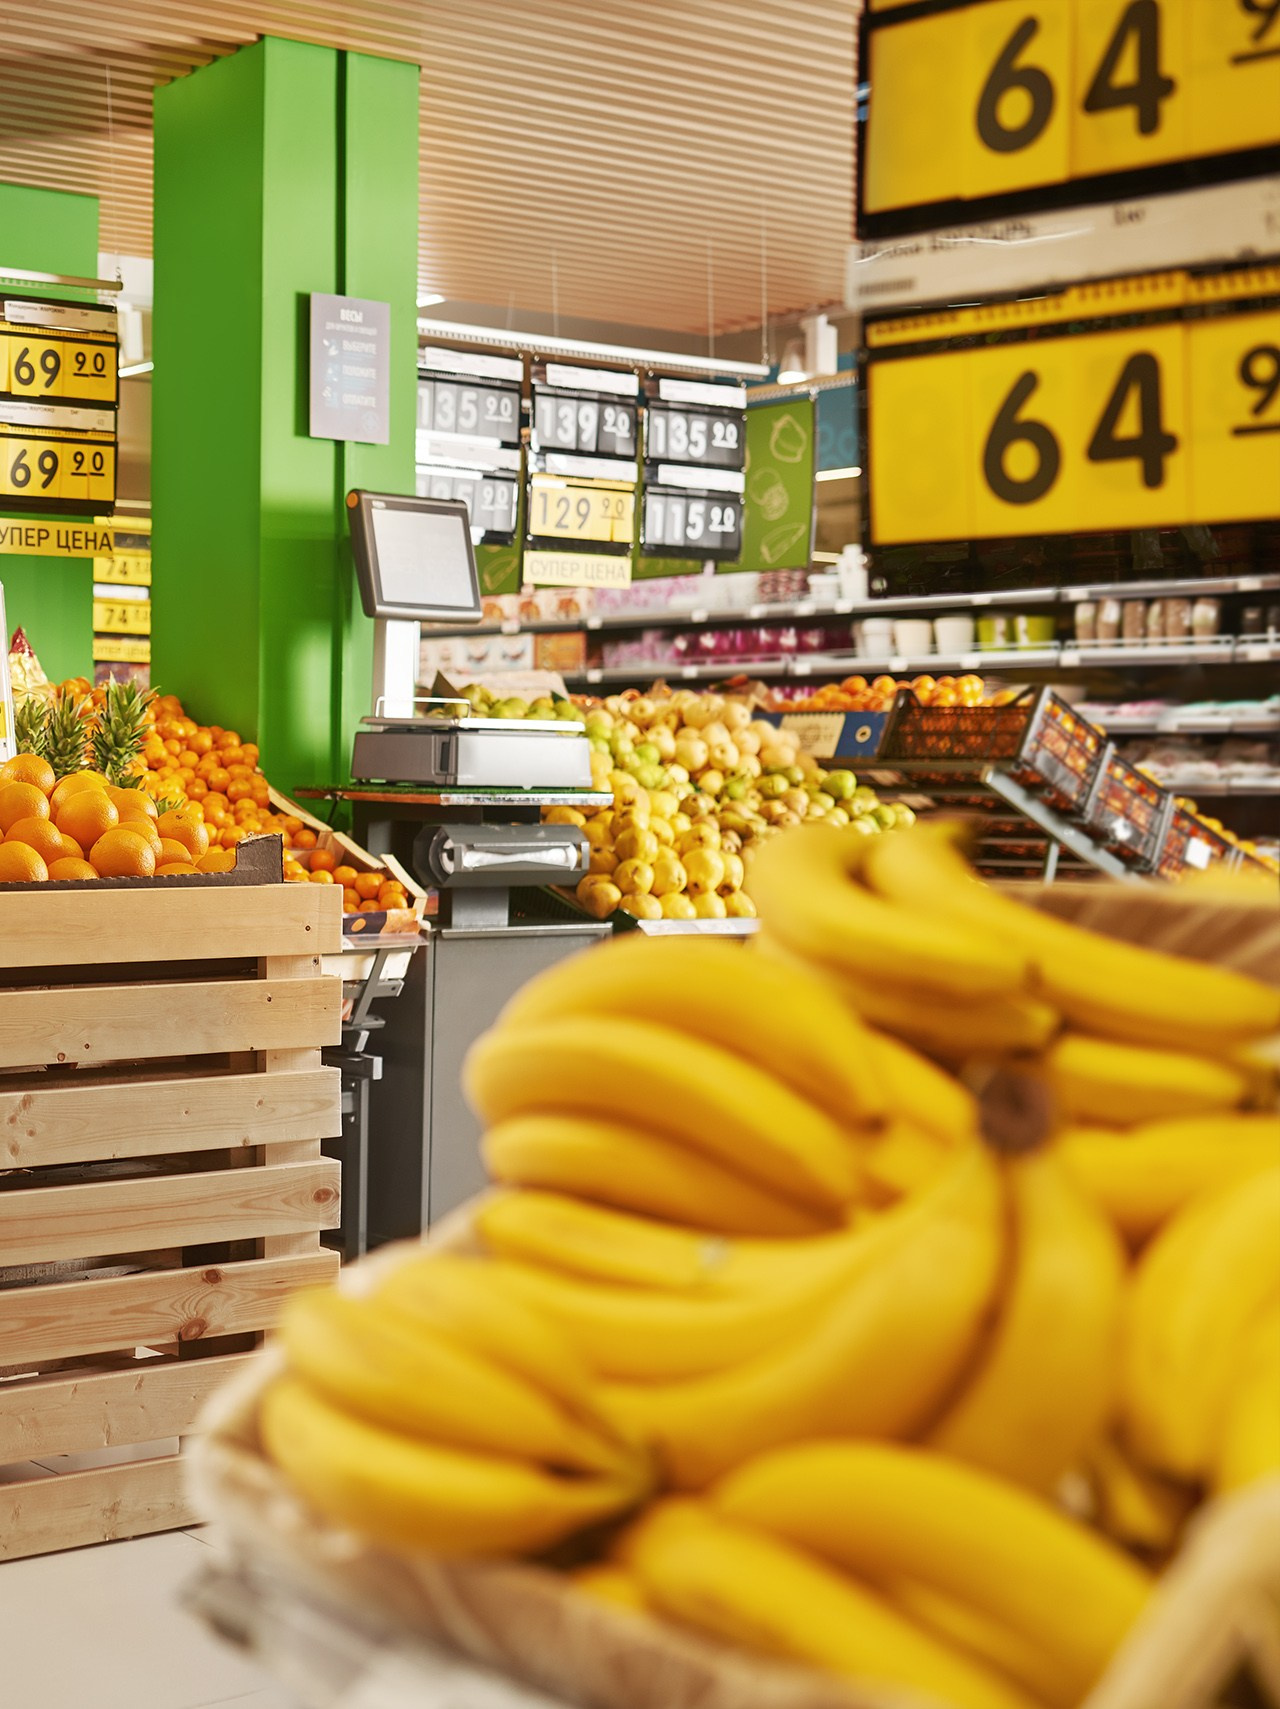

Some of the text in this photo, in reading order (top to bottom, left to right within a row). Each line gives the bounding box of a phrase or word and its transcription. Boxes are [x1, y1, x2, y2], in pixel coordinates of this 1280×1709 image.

[976, 0, 1177, 153] 64
[14, 347, 106, 389] 69 90
[417, 387, 513, 429] 135 90
[540, 400, 630, 444] 139 90
[982, 350, 1178, 506] 64
[654, 415, 738, 458] 135 90
[10, 448, 104, 489] 69 90
[482, 485, 509, 508] 90
[539, 492, 624, 531] 129 90
[57, 529, 112, 553] ЦЕНА
[652, 502, 735, 540] 115 90
[529, 558, 627, 581] СУПЕР ЦЕНА
